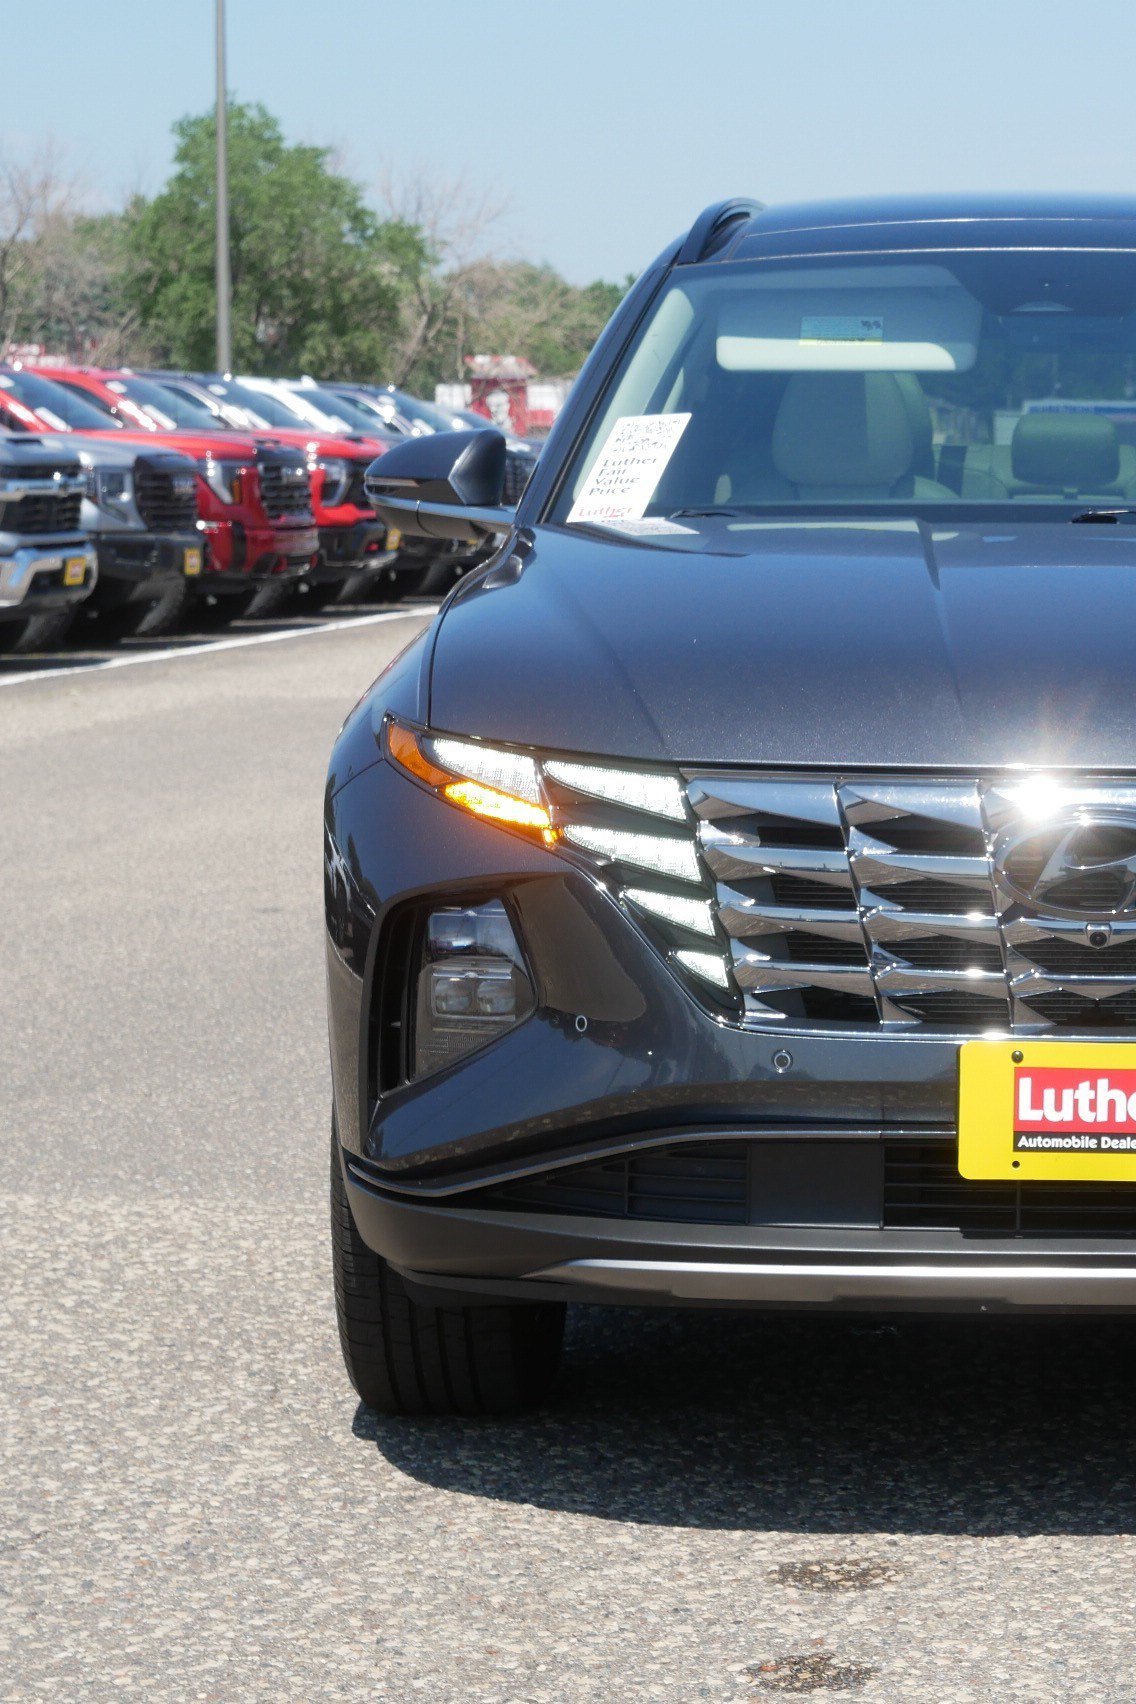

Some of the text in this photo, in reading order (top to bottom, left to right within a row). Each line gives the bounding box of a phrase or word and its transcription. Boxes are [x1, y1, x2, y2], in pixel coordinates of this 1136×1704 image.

[603, 458, 657, 467] Luther
[595, 477, 640, 486] Value
[588, 487, 631, 496] Price
[1017, 1136, 1098, 1149] Automobile
